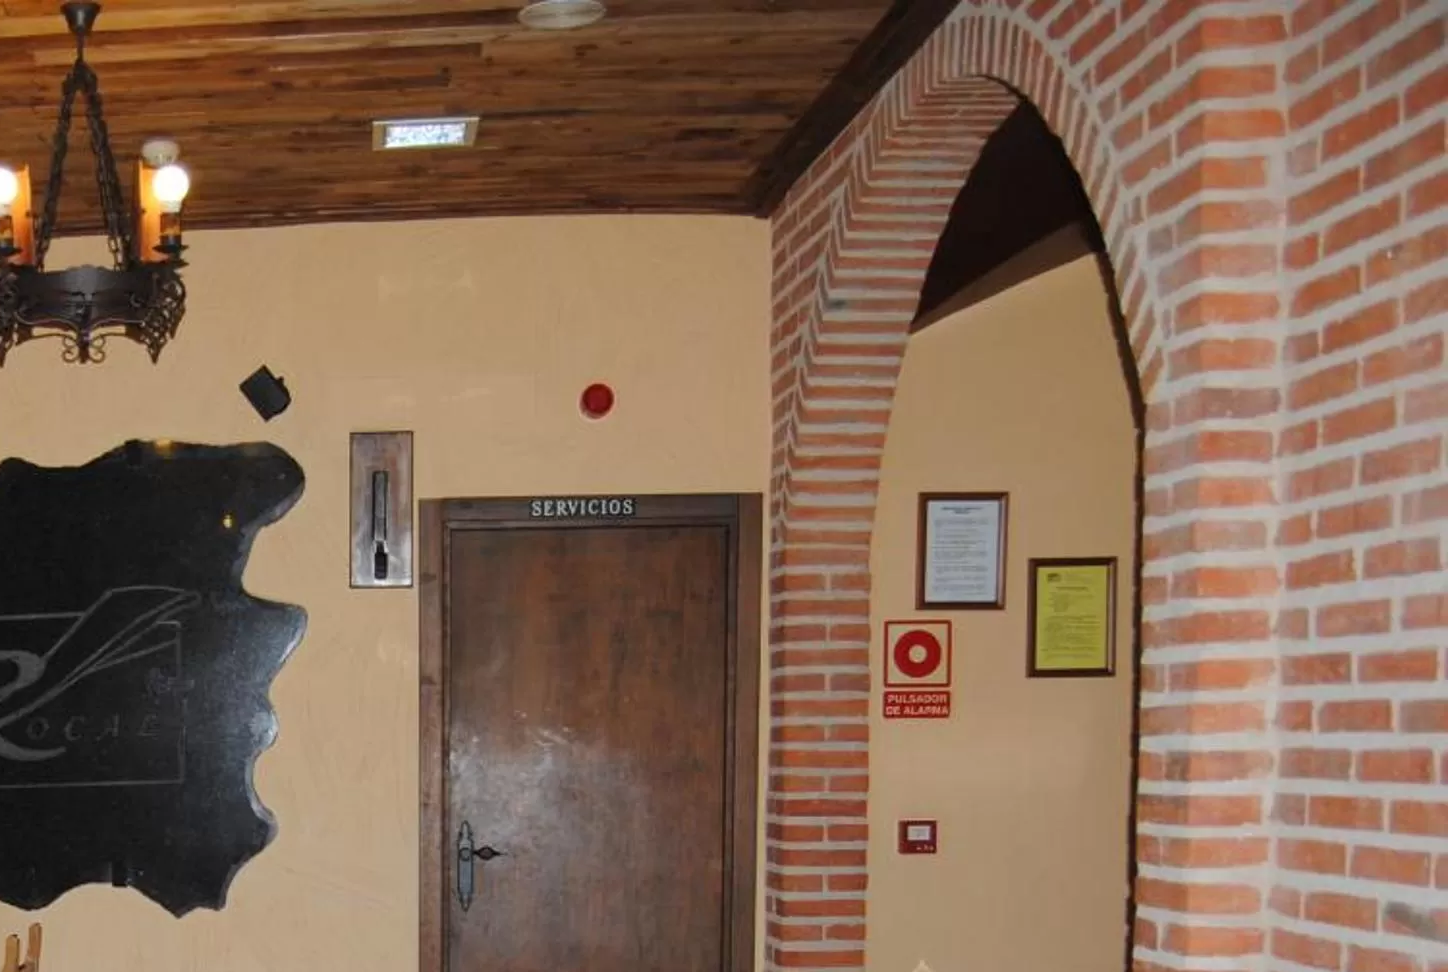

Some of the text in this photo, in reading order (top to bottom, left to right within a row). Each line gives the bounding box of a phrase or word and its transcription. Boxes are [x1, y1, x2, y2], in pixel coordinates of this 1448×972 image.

[531, 499, 634, 517] SERVICIOS
[887, 694, 948, 704] PULSADOR
[885, 705, 949, 715] DE ALARMA
